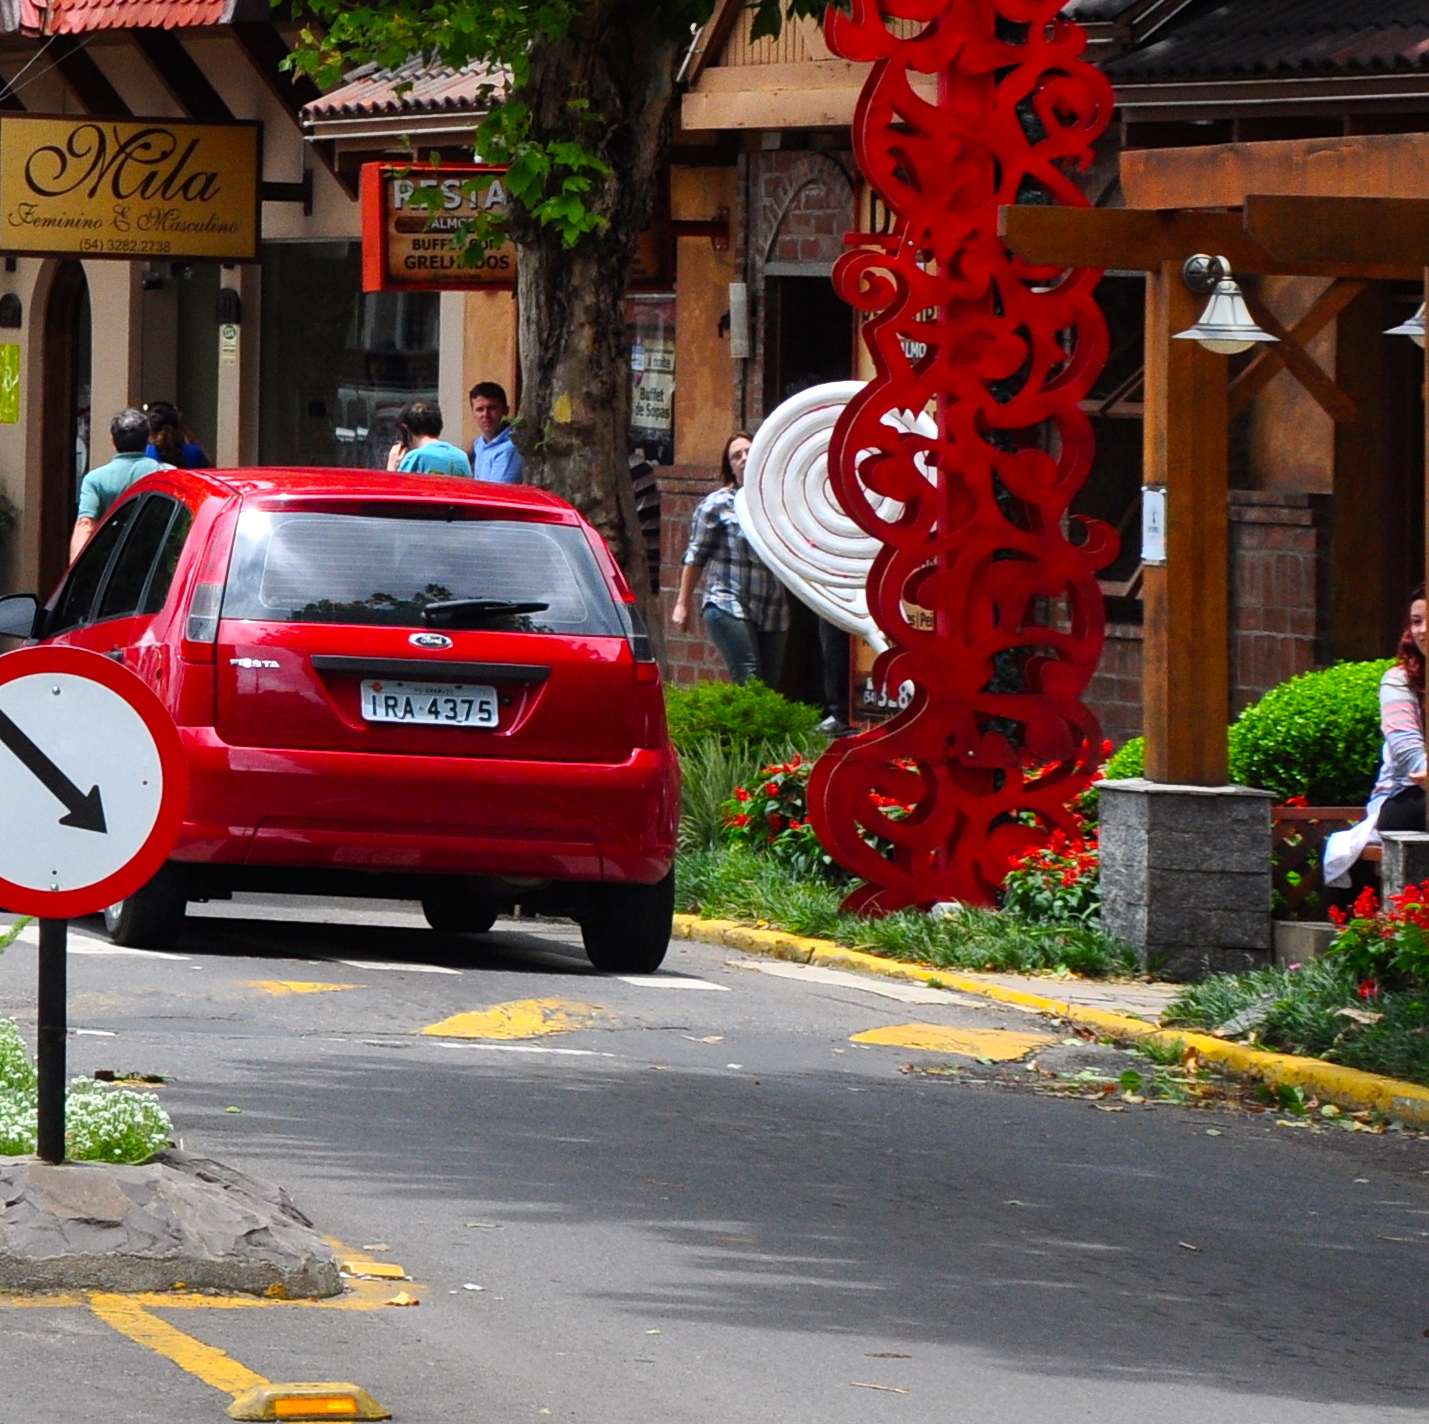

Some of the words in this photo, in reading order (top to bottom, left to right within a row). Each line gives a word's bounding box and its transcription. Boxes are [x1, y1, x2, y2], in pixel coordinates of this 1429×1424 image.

[24, 123, 222, 202] Mila
[7, 201, 103, 230] Feminino
[136, 206, 240, 234] Masculino
[78, 239, 104, 252] (54)
[412, 238, 463, 250] BUFF
[404, 255, 510, 270] GRELHDOS
